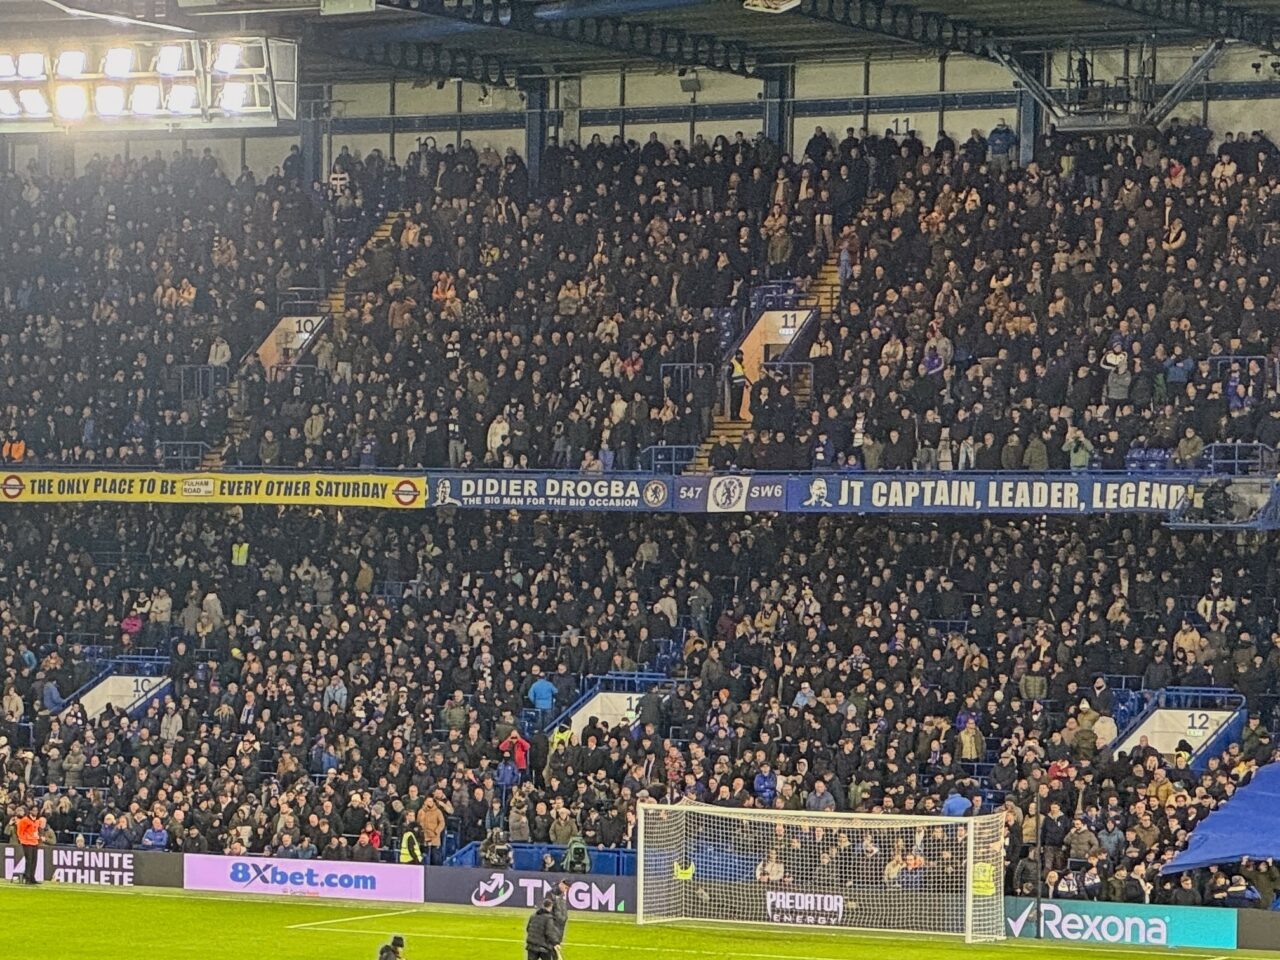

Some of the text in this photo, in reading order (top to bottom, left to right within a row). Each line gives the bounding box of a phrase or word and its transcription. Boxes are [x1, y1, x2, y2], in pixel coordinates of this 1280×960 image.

[891, 117, 910, 136] 11
[295, 319, 314, 334] 10
[781, 313, 797, 329] 11
[30, 478, 177, 495] THE ONLY PLACE TO BE
[220, 479, 388, 499] EVERY OTHER SATURDAY
[461, 478, 538, 496] DIDIER
[546, 478, 641, 498] DROGBA
[679, 486, 702, 499] 547
[750, 485, 783, 498] SW6
[838, 480, 864, 507] JT
[871, 480, 982, 510] CAPTAIN,
[988, 481, 1086, 511] LEADER,
[463, 496, 639, 507] THE BIG MAN FOR THE BIG OCCASION
[1187, 713, 1210, 730] 12
[52, 850, 134, 869] INFINITE
[51, 868, 134, 887] ATHLETE
[230, 862, 377, 890] 8Xbet.com
[766, 891, 844, 918] PREDATOR
[773, 913, 838, 925] ENERGY
[1040, 903, 1168, 945] Rexona
